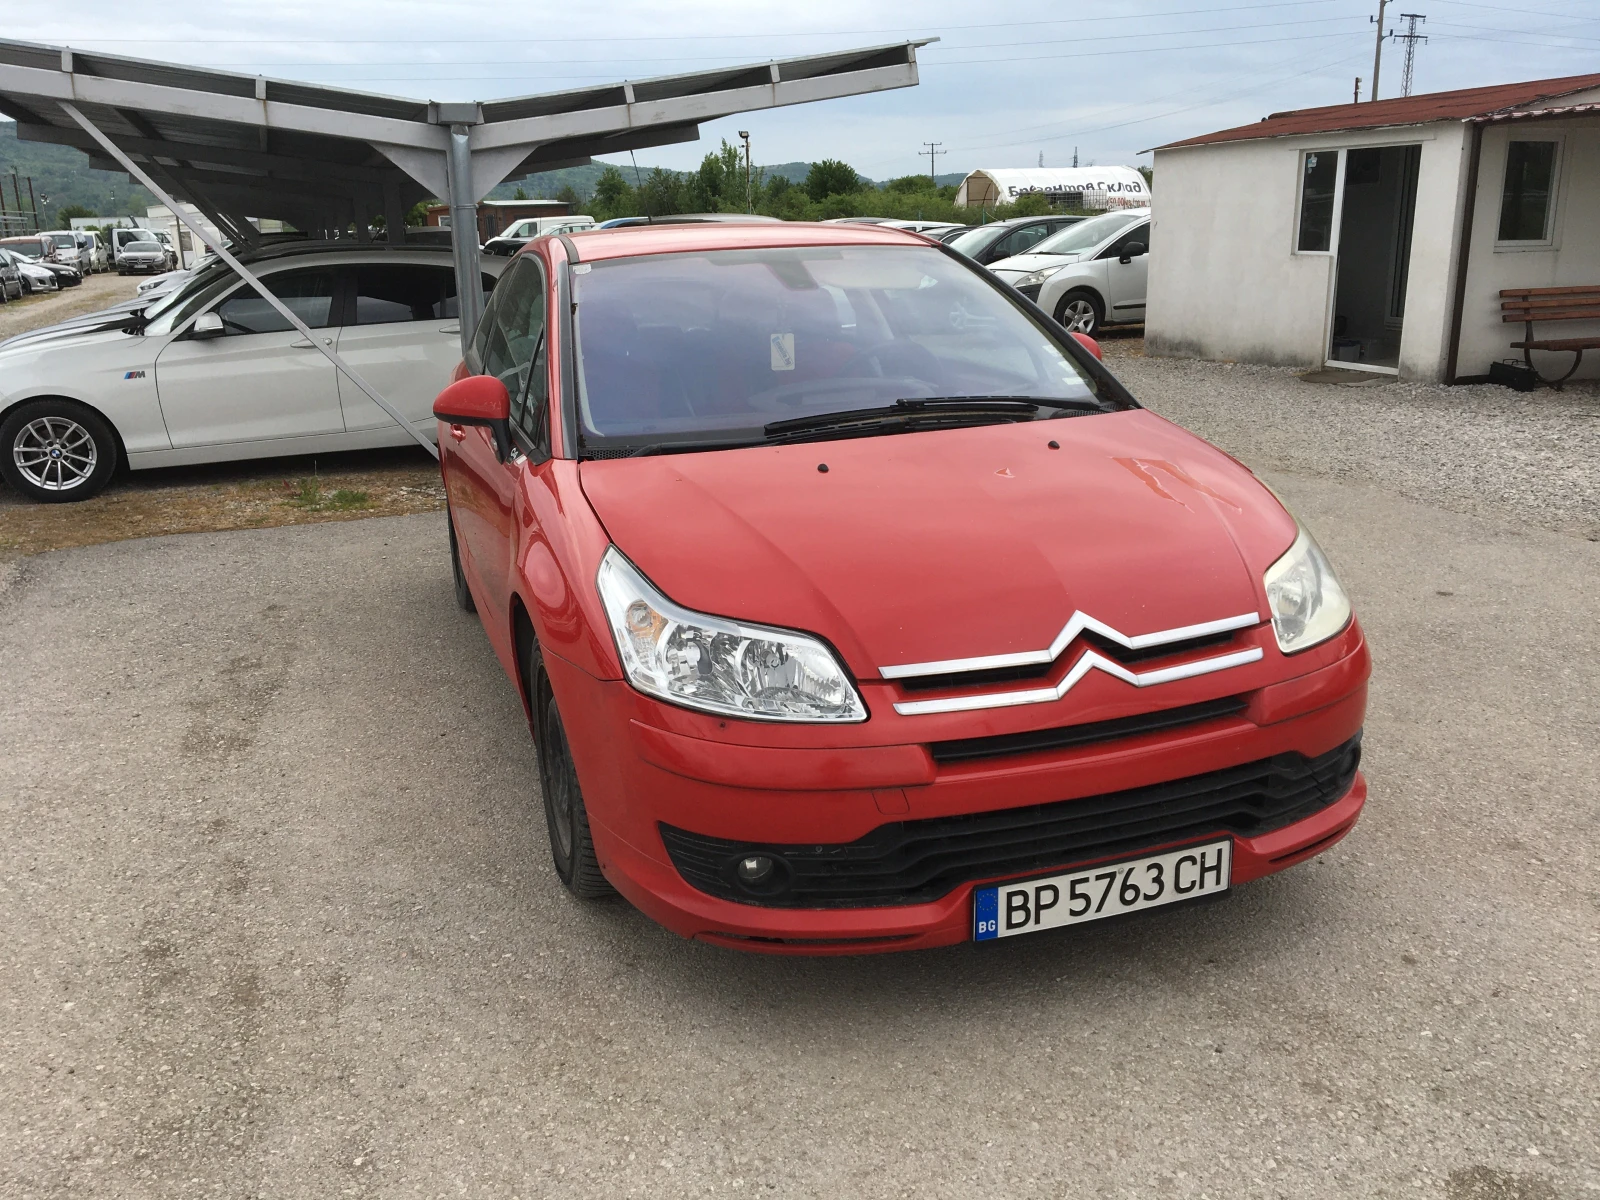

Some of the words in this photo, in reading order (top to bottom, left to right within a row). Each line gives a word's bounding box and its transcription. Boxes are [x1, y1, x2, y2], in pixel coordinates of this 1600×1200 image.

[1006, 884, 1060, 931] BP
[1069, 862, 1165, 917] 5763
[1174, 848, 1223, 894] CH
[978, 920, 996, 934] BG
